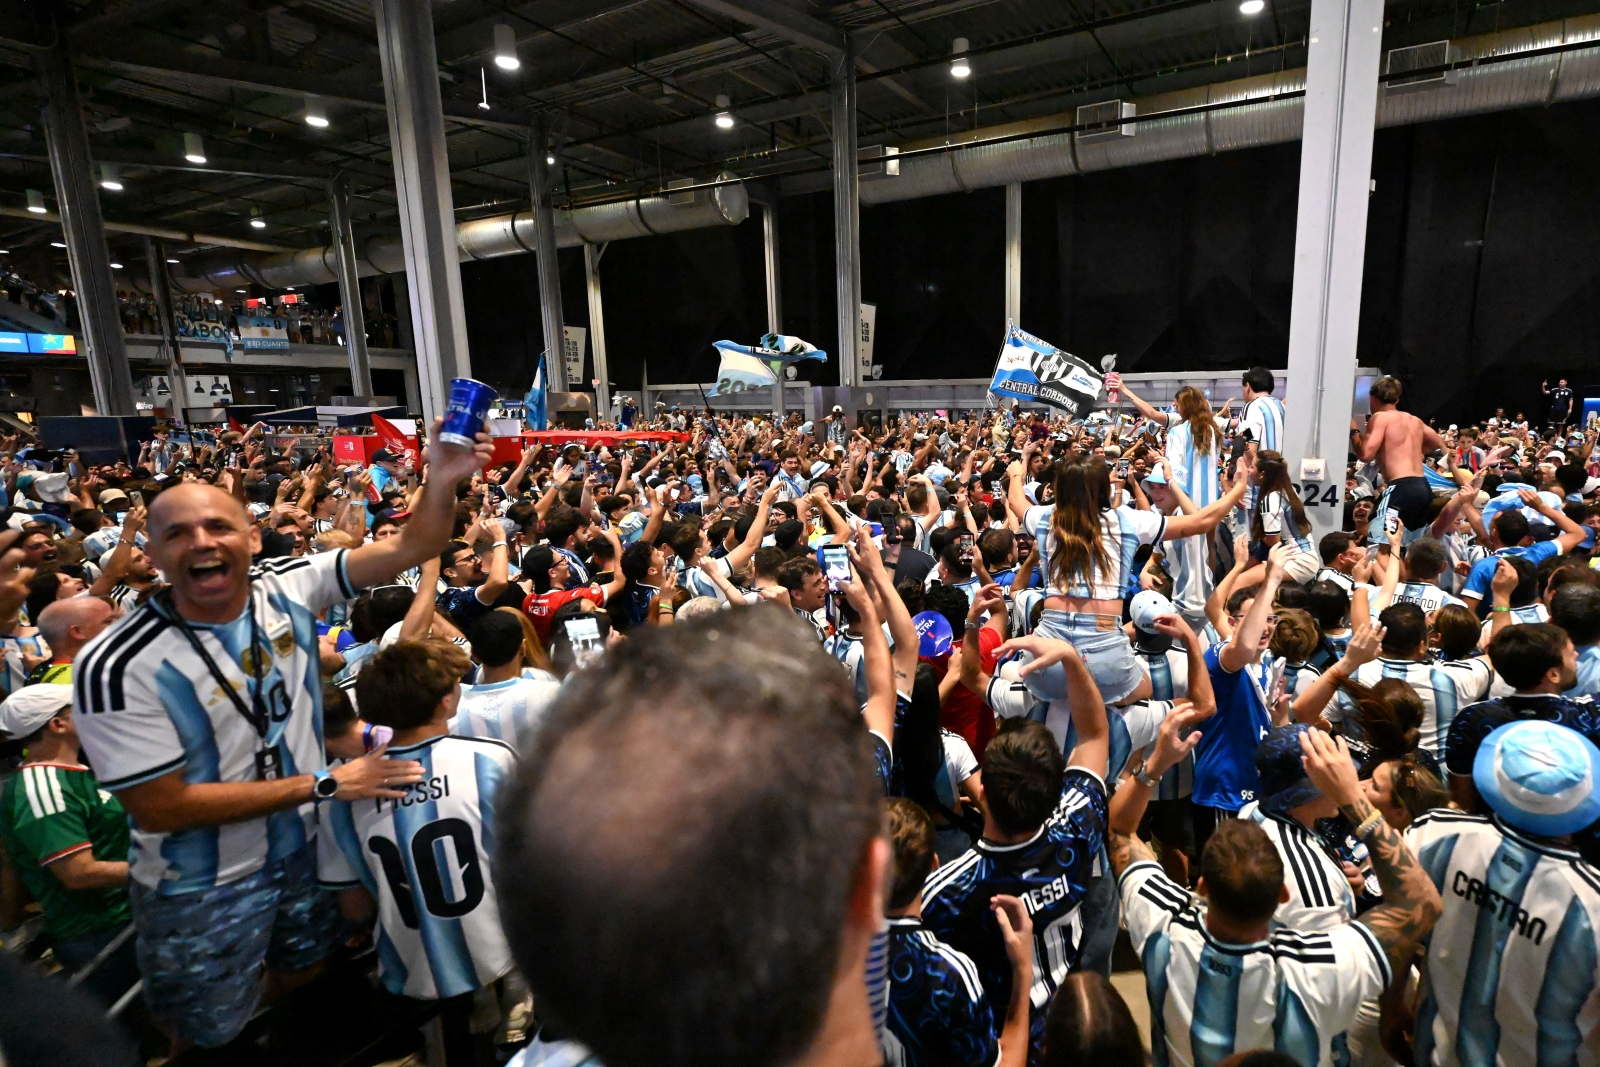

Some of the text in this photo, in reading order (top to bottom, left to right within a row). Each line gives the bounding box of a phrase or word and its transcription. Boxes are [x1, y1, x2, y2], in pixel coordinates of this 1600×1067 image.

[999, 379, 1079, 414] CENTRAL CORDOBA
[1393, 594, 1438, 610] TAMENDI
[1241, 789, 1254, 800] 95
[368, 817, 485, 930] 10
